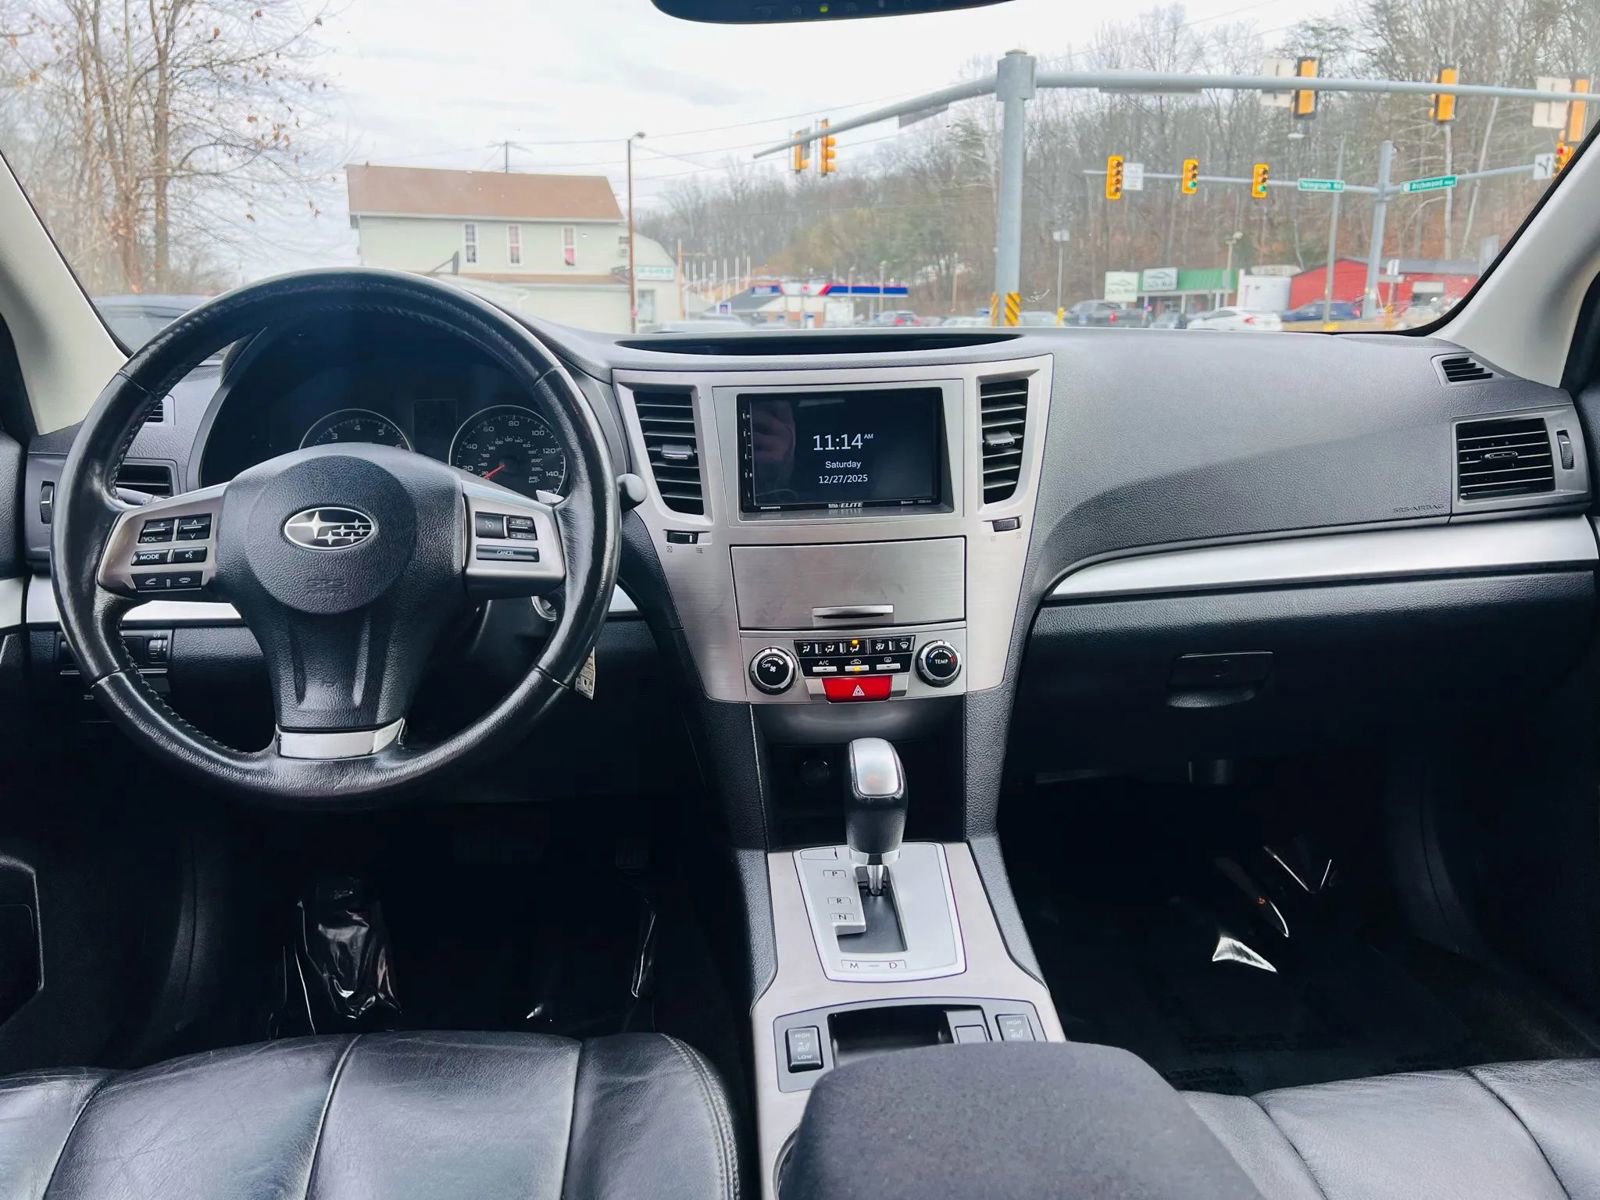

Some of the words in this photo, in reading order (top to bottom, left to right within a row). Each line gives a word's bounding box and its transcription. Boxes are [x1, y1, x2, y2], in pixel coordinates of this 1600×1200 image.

[331, 432, 338, 440] 3
[812, 433, 863, 451] 11:14
[825, 460, 862, 469] Saturday
[818, 473, 868, 484] 12/27/2025
[139, 553, 160, 561] MODE
